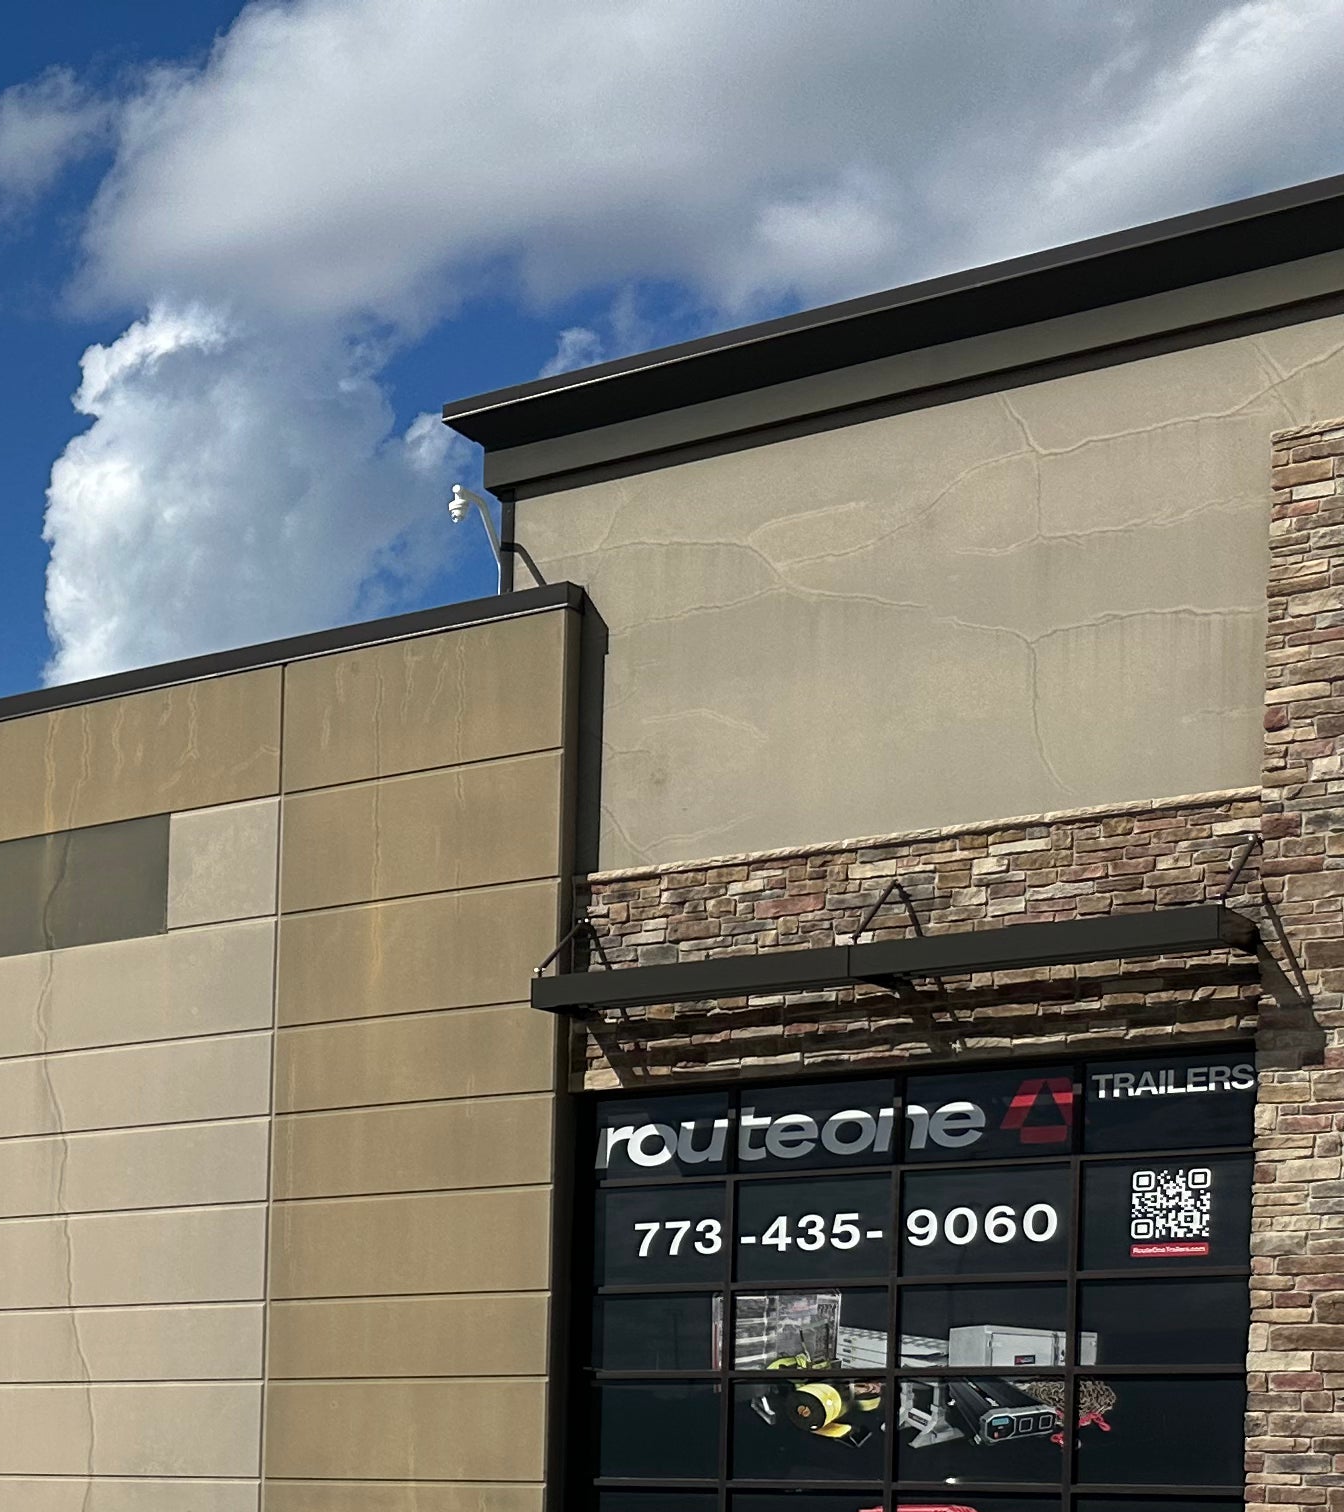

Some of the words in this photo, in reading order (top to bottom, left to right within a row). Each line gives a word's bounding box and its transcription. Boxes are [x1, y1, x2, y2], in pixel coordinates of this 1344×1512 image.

[1092, 1064, 1256, 1099] TRAILERS
[595, 1100, 986, 1169] routeone
[634, 1219, 723, 1257] 773
[906, 1203, 1060, 1247] 9060
